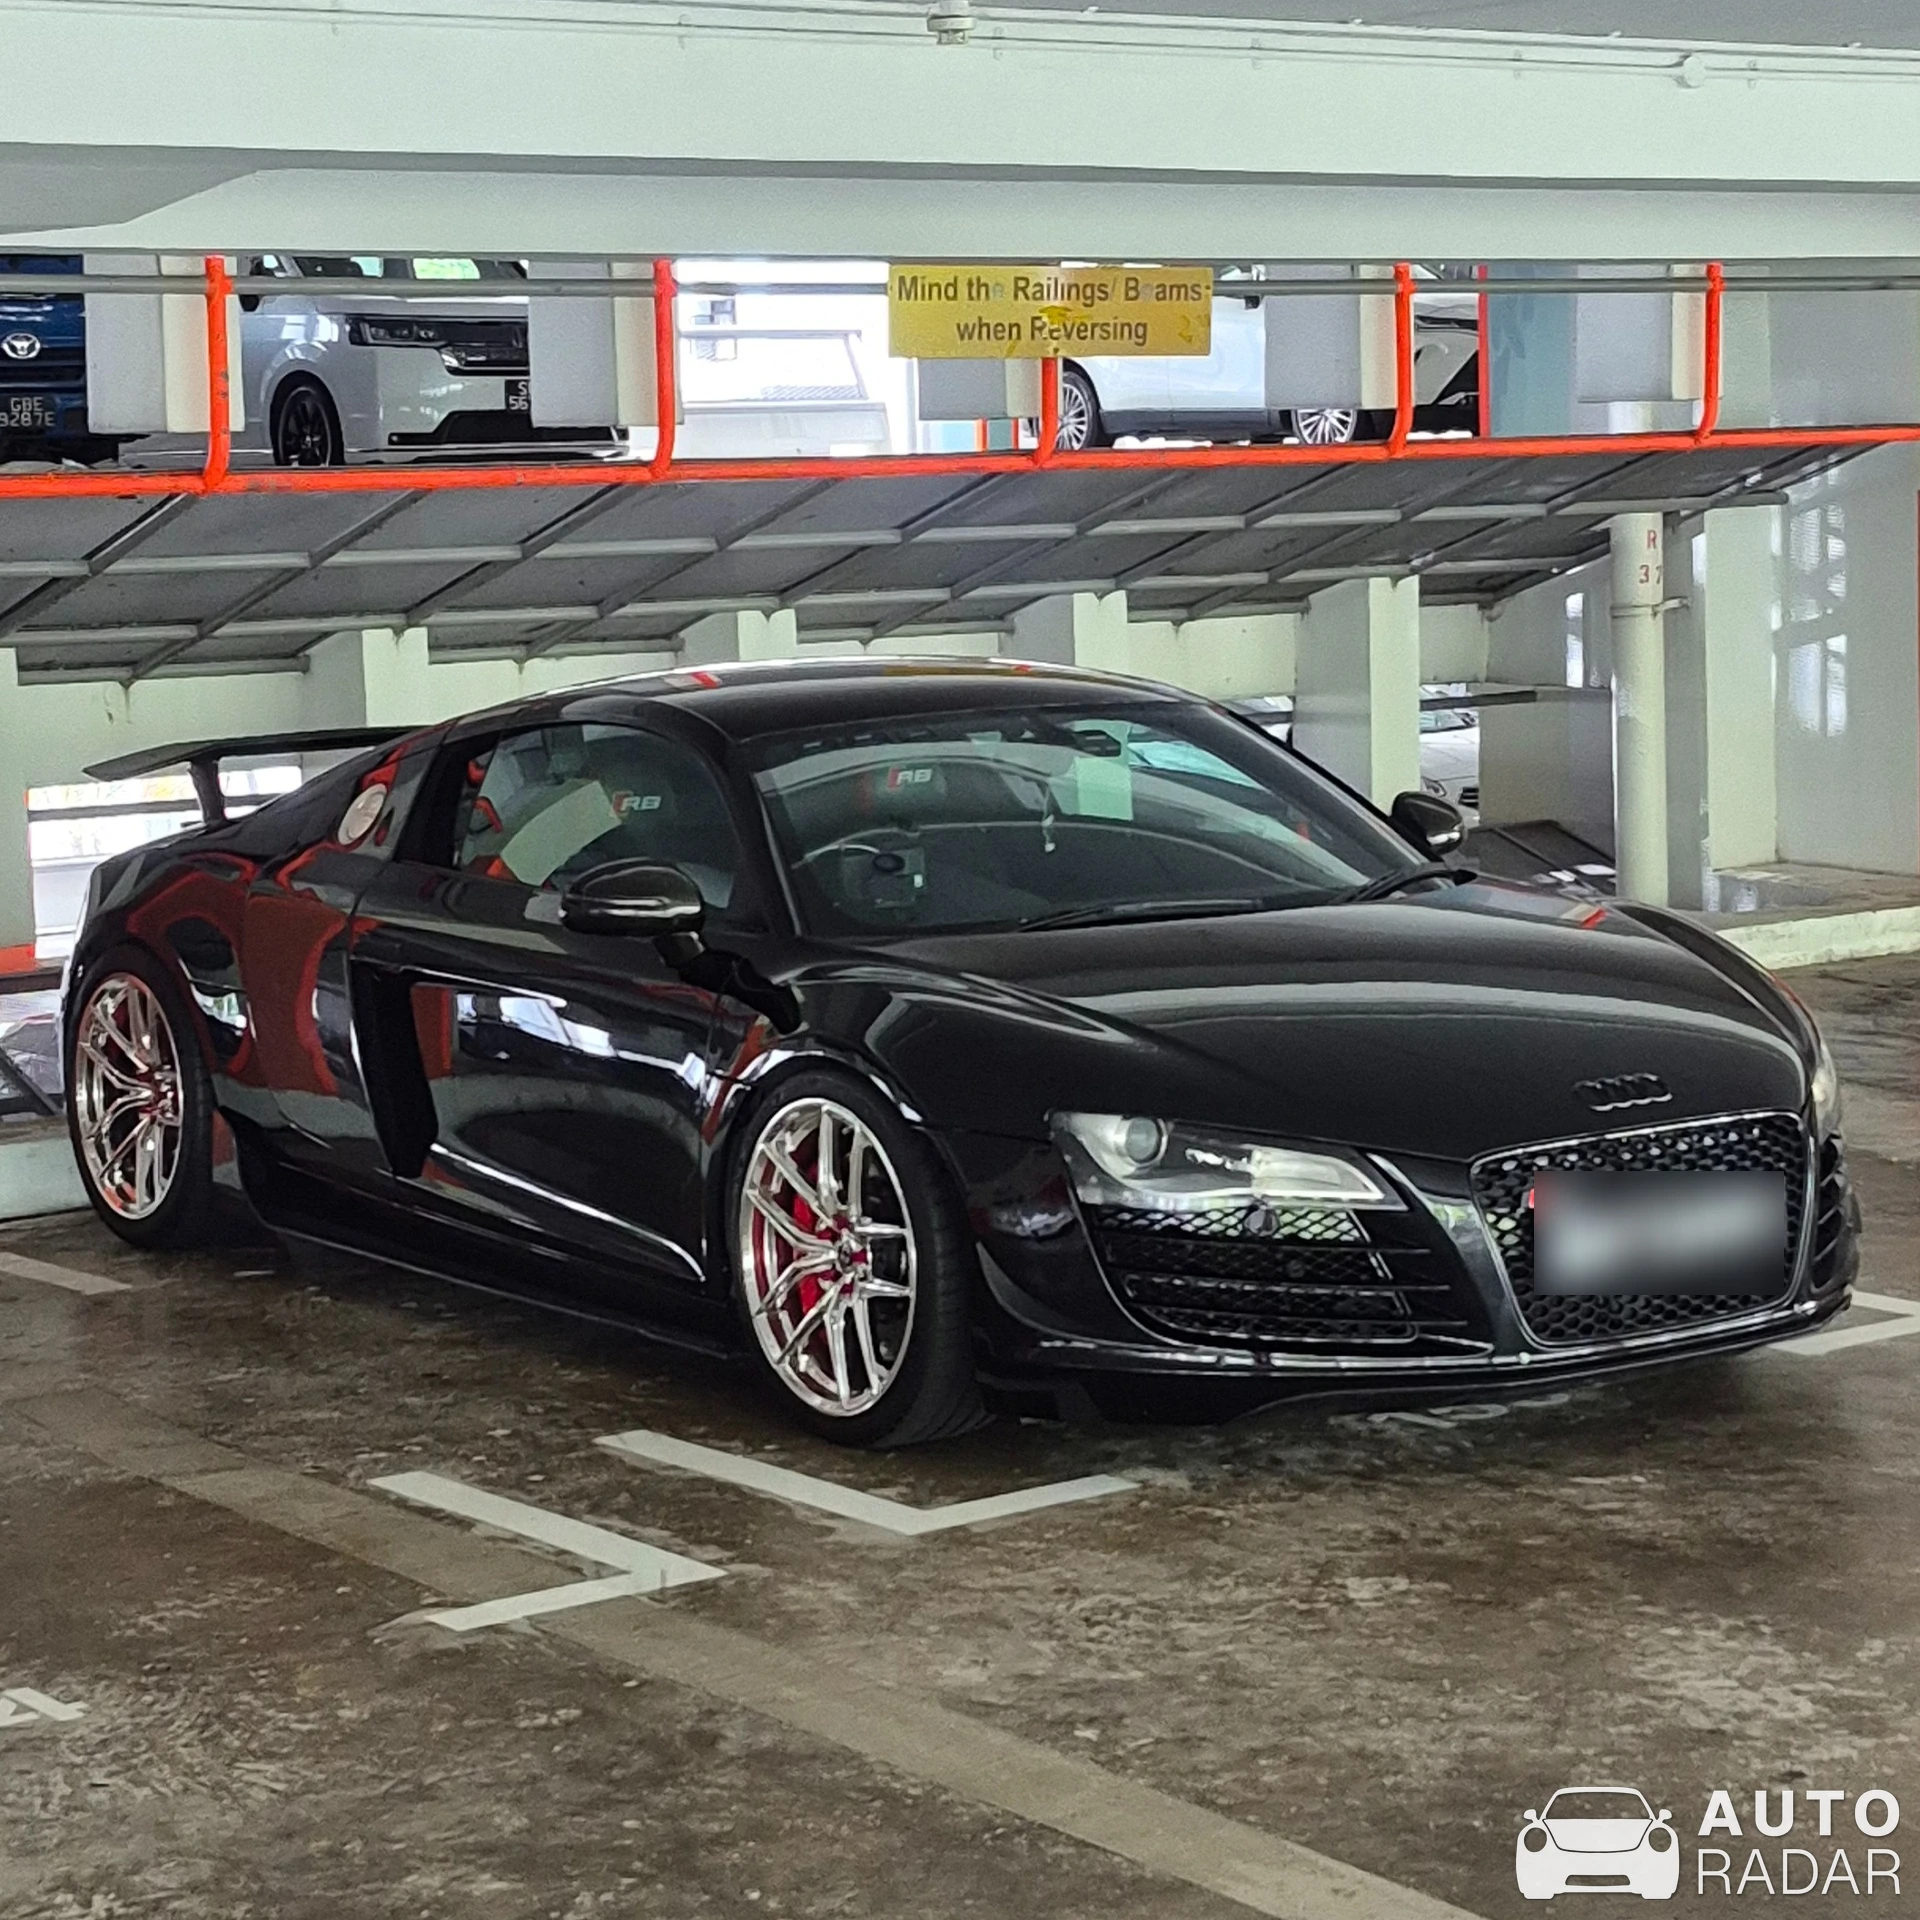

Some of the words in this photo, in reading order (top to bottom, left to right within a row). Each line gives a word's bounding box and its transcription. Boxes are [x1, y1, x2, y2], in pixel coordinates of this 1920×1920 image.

[898, 275, 957, 302] Mind
[956, 316, 1022, 342] when
[1030, 315, 1149, 346] Reversing
[10, 396, 44, 412] GBE
[0, 411, 56, 427] 9287E
[1646, 529, 1657, 549] R
[890, 767, 932, 786] R8
[615, 793, 661, 813] R8
